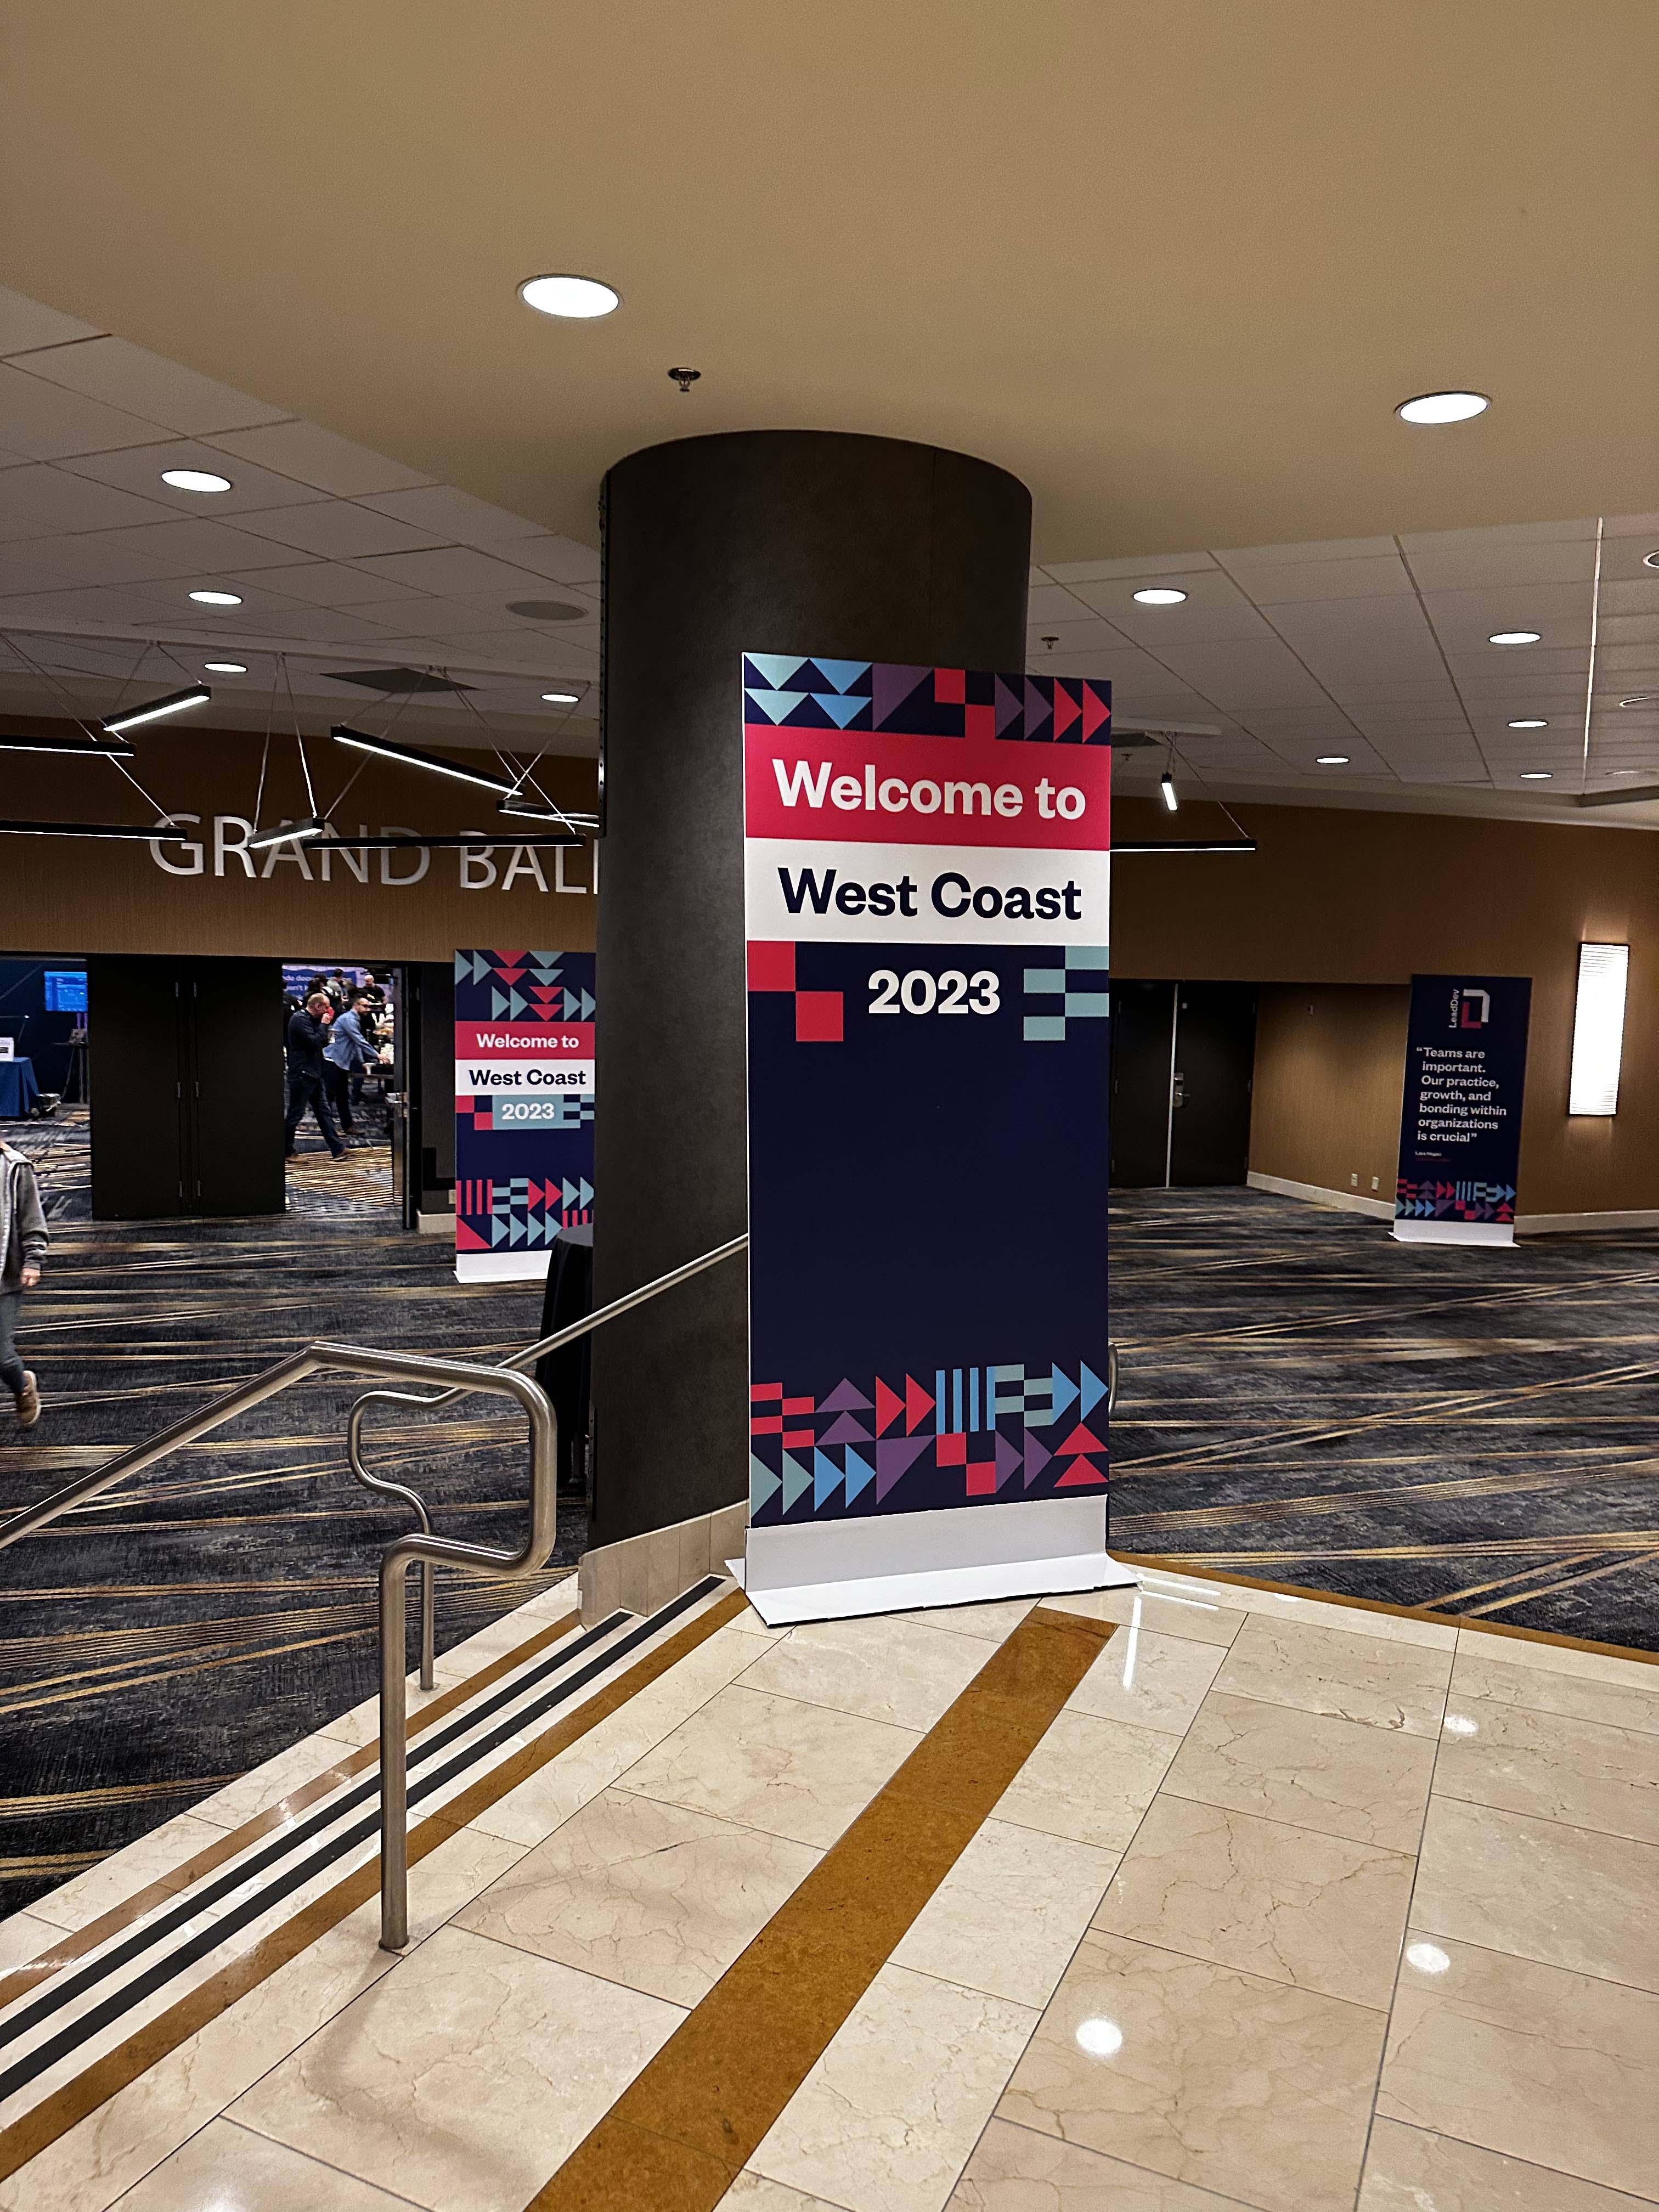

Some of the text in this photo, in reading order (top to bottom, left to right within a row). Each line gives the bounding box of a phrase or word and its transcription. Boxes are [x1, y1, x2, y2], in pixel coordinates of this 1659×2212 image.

[772, 759, 1086, 820] Welcome to
[149, 814, 430, 885] GRAND
[777, 867, 1082, 920] West Coast
[868, 970, 1001, 1015] 2023
[1448, 988, 1459, 1028] LeadDev
[476, 1033, 579, 1048] Welcome to
[1465, 1051, 1486, 1059] are
[1422, 1061, 1486, 1073] important.
[469, 1069, 586, 1086] West Coast
[1421, 1075, 1499, 1089] Our practice,
[1420, 1088, 1492, 1102] growth, and
[501, 1103, 554, 1120] 2023
[1419, 1103, 1507, 1116] bonding within
[1418, 1118, 1499, 1130] organizations
[1417, 1131, 1427, 1141] is
